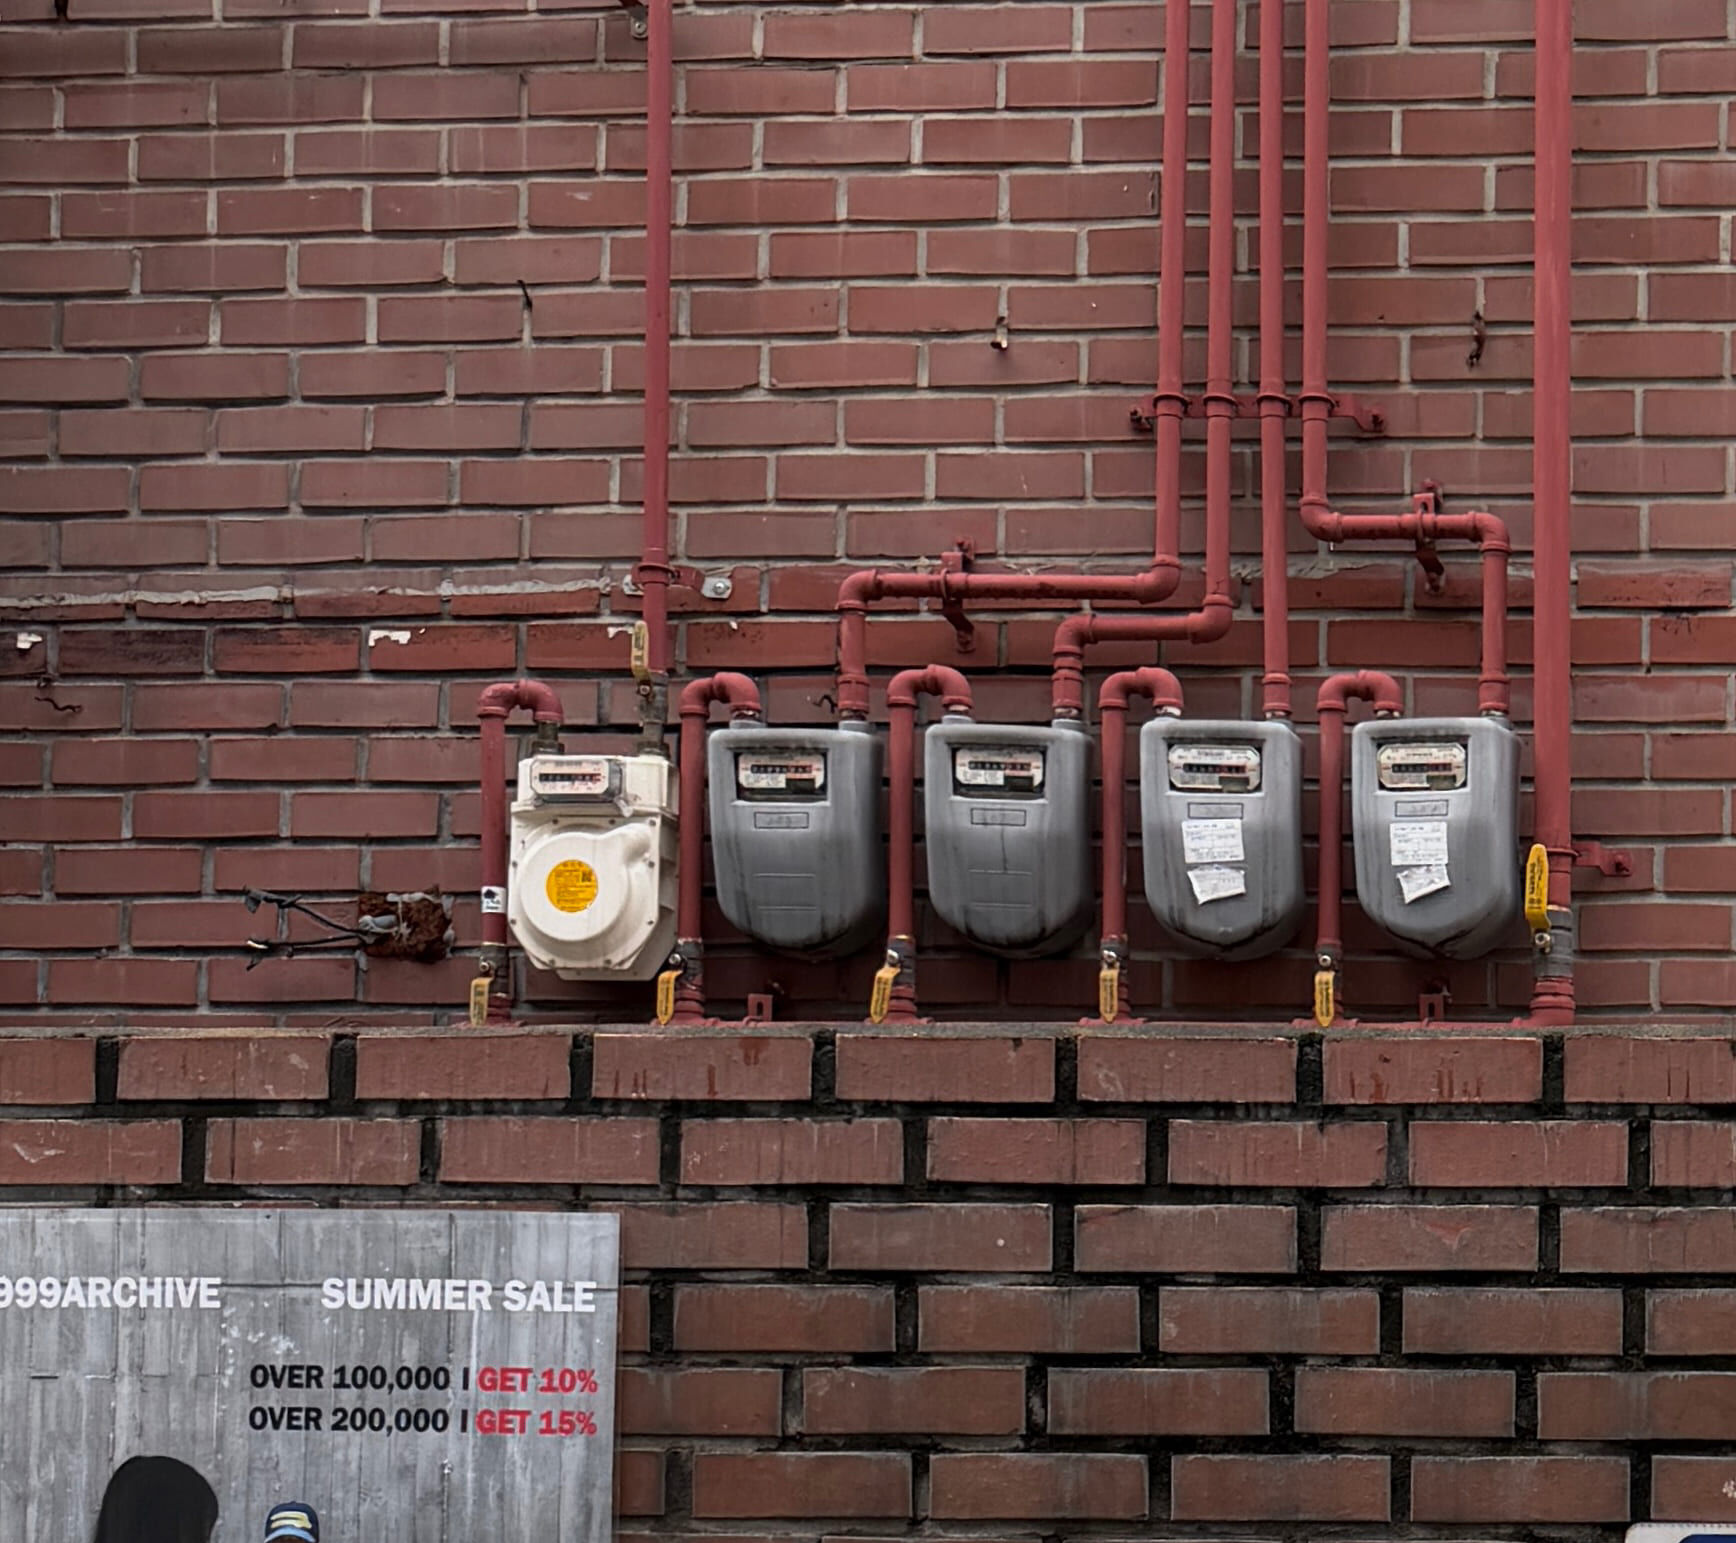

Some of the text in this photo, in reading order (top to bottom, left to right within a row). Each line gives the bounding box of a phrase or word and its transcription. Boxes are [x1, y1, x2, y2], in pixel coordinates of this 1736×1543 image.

[320, 1277, 597, 1313] SUMMER SALE
[250, 1364, 324, 1389] OVER
[332, 1365, 450, 1394] 100,000
[477, 1366, 534, 1392] GET
[539, 1367, 598, 1393] 10%
[248, 1406, 323, 1431] OVER
[331, 1407, 449, 1437] 200,000
[475, 1408, 532, 1434] GET
[538, 1409, 598, 1436] 15%
